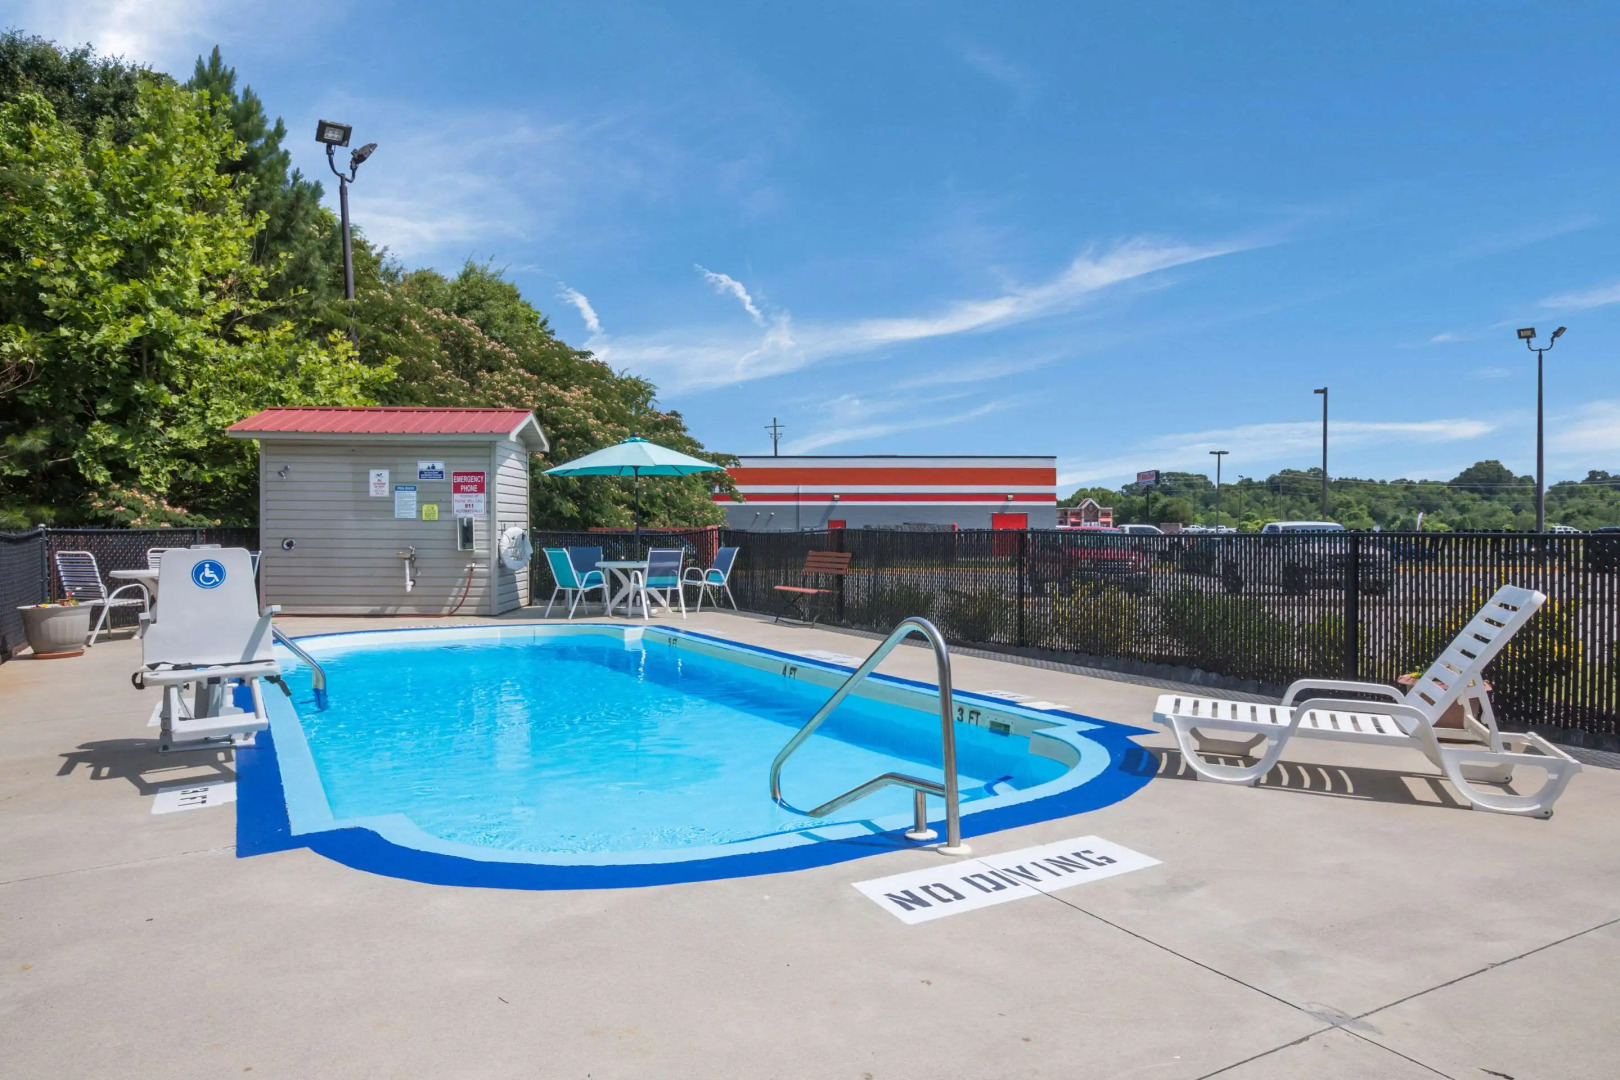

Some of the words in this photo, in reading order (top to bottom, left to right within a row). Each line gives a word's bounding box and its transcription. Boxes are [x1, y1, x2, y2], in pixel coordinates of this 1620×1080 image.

[453, 475, 484, 483] EMERGENCY
[460, 484, 478, 492] PHONE
[672, 638, 677, 648] FT
[782, 665, 787, 677] 4
[789, 667, 797, 679] FT
[957, 707, 964, 722] 3
[968, 710, 981, 726] FT
[884, 882, 966, 911] NO
[960, 850, 1118, 894] DIVING
